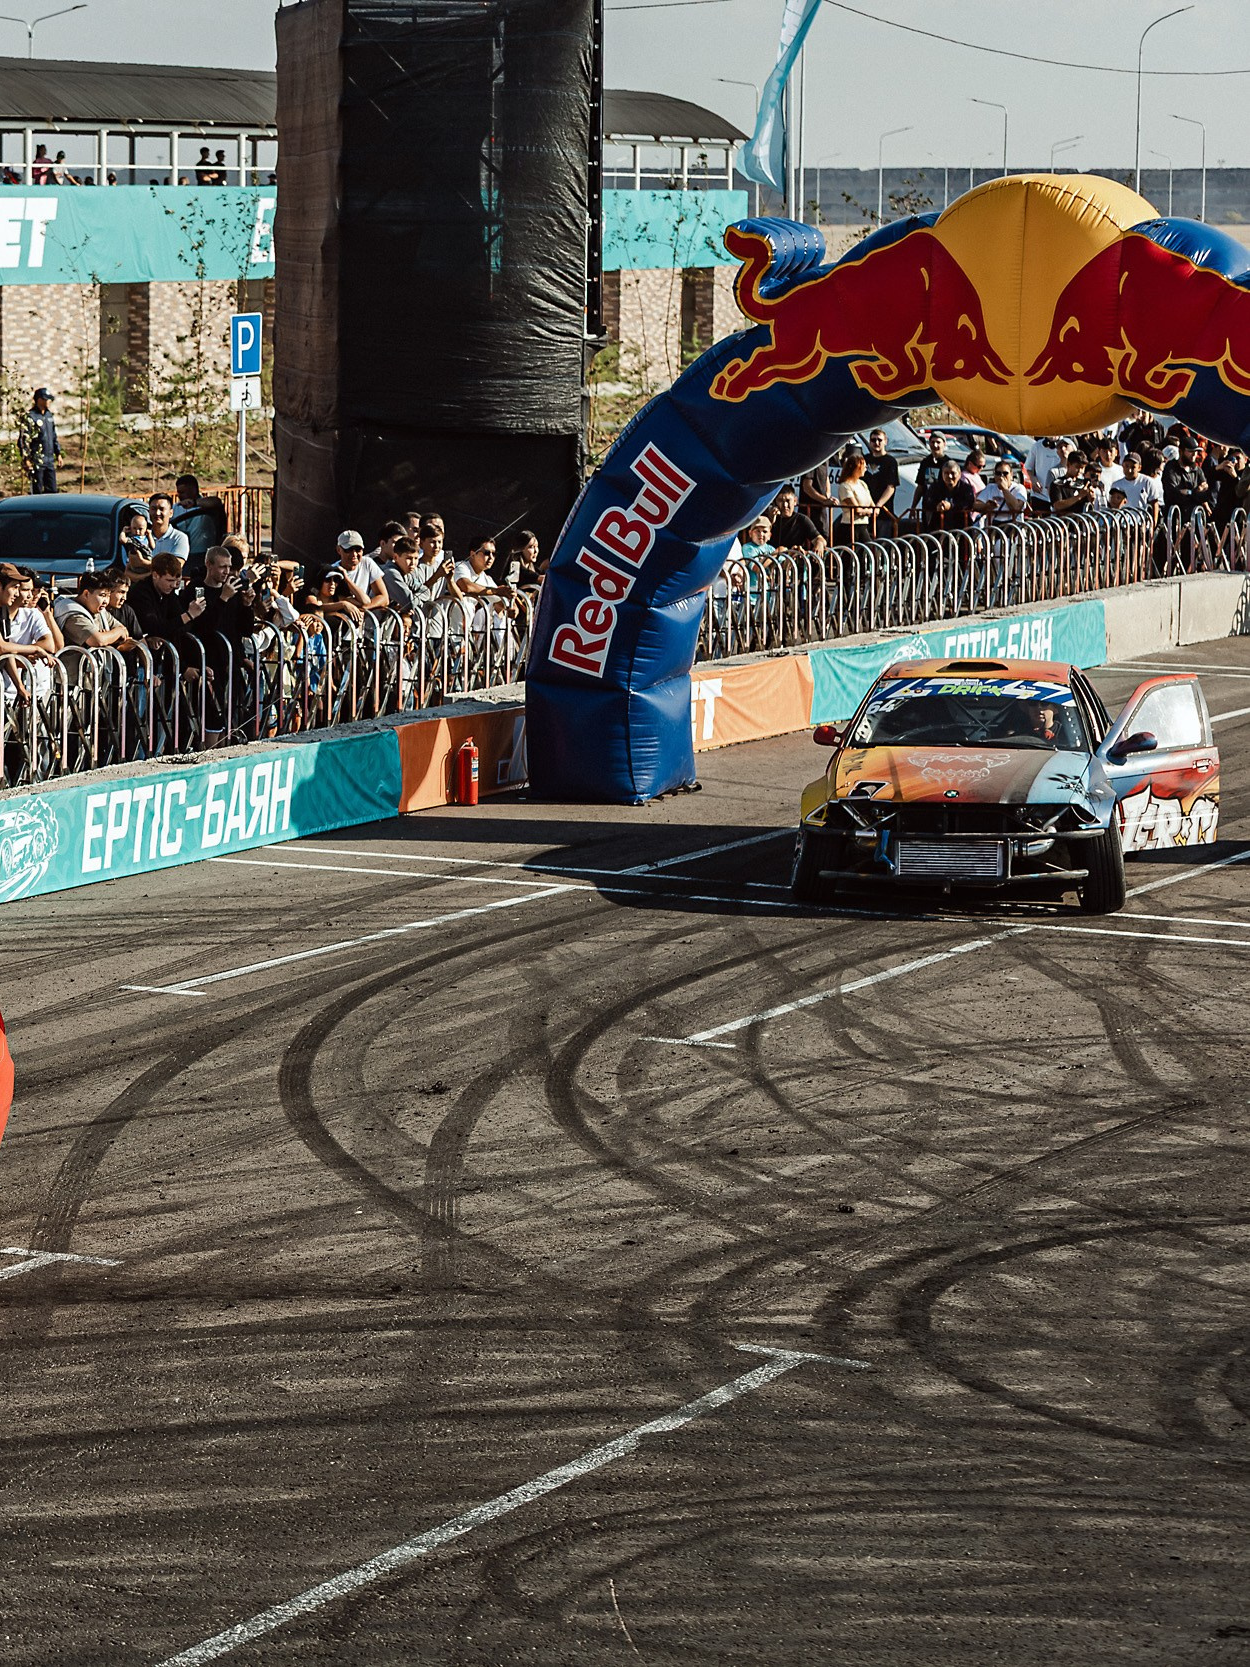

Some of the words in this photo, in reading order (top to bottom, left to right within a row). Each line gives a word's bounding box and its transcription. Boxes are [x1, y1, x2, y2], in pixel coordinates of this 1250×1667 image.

[237, 321, 255, 369] P
[590, 441, 697, 568] Bull
[548, 546, 637, 679] Red
[866, 700, 896, 714] 64
[81, 757, 296, 874] ЕРТІС-БАЯН
